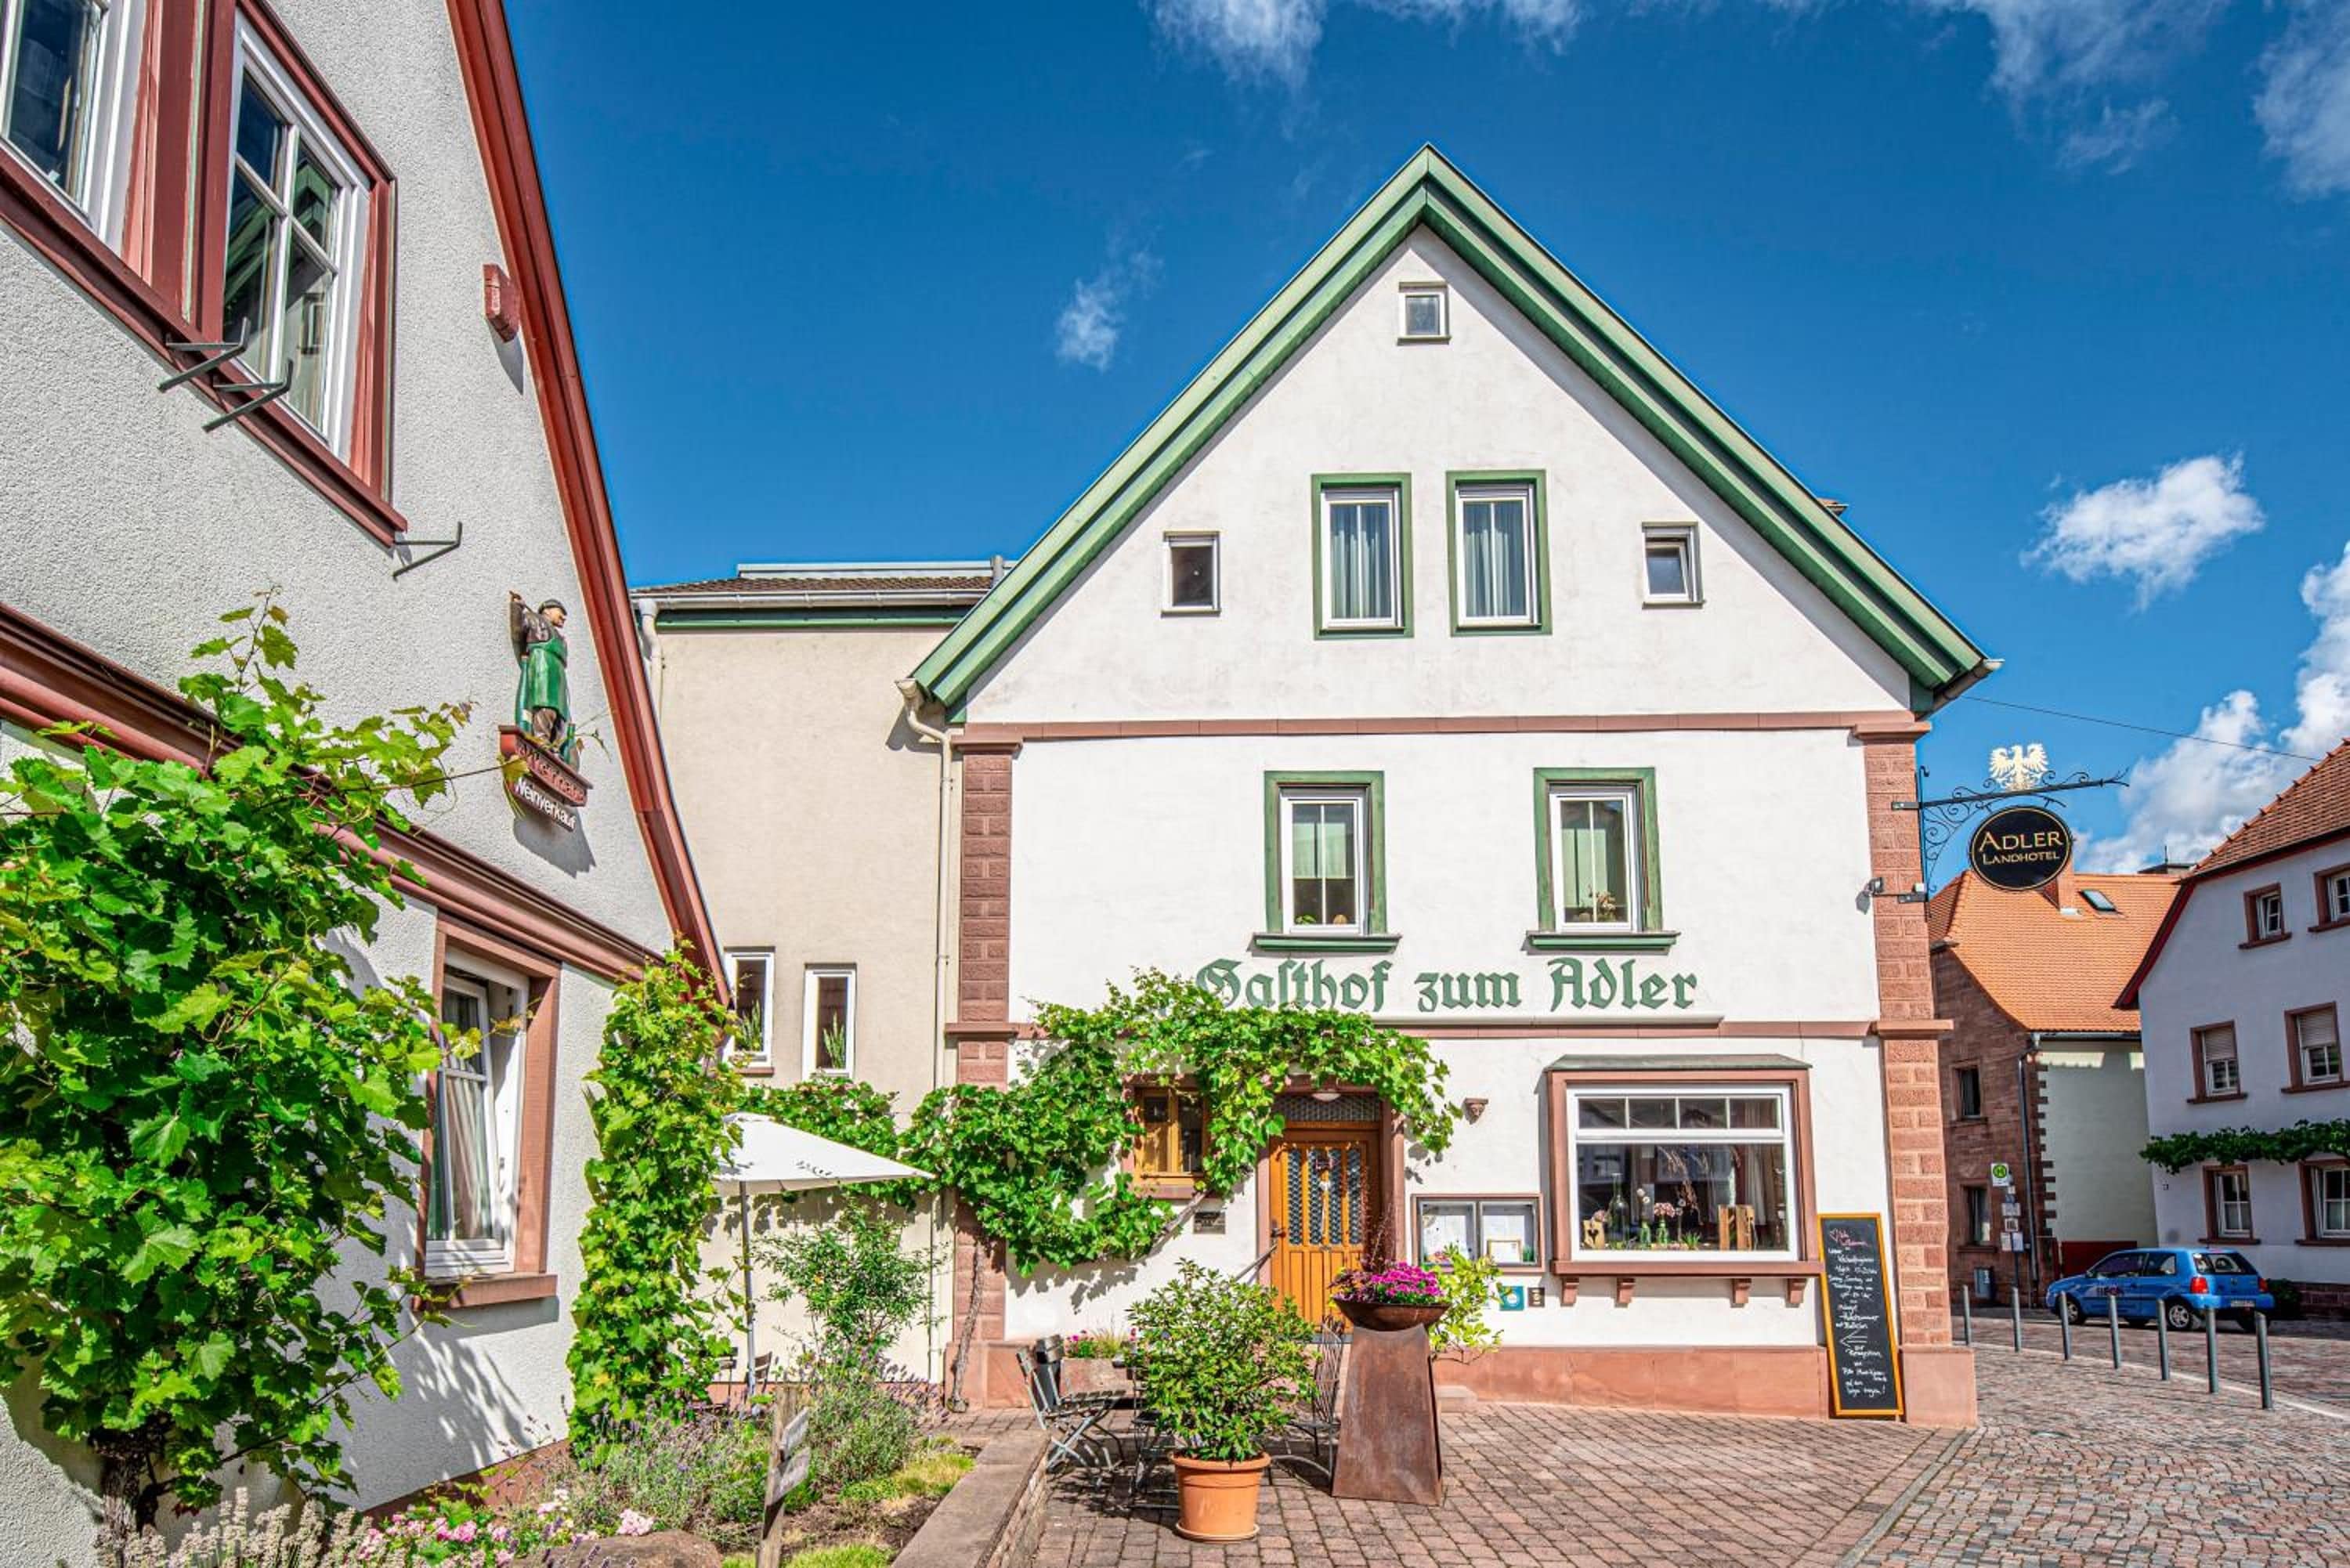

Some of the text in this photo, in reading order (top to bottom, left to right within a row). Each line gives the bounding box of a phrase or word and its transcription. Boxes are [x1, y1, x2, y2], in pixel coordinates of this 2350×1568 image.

[1979, 830, 2064, 852] ADLER
[1983, 851, 2060, 865] LANDHOTEL
[1414, 970, 1522, 1013] zum
[1546, 957, 1698, 1013] Adler
